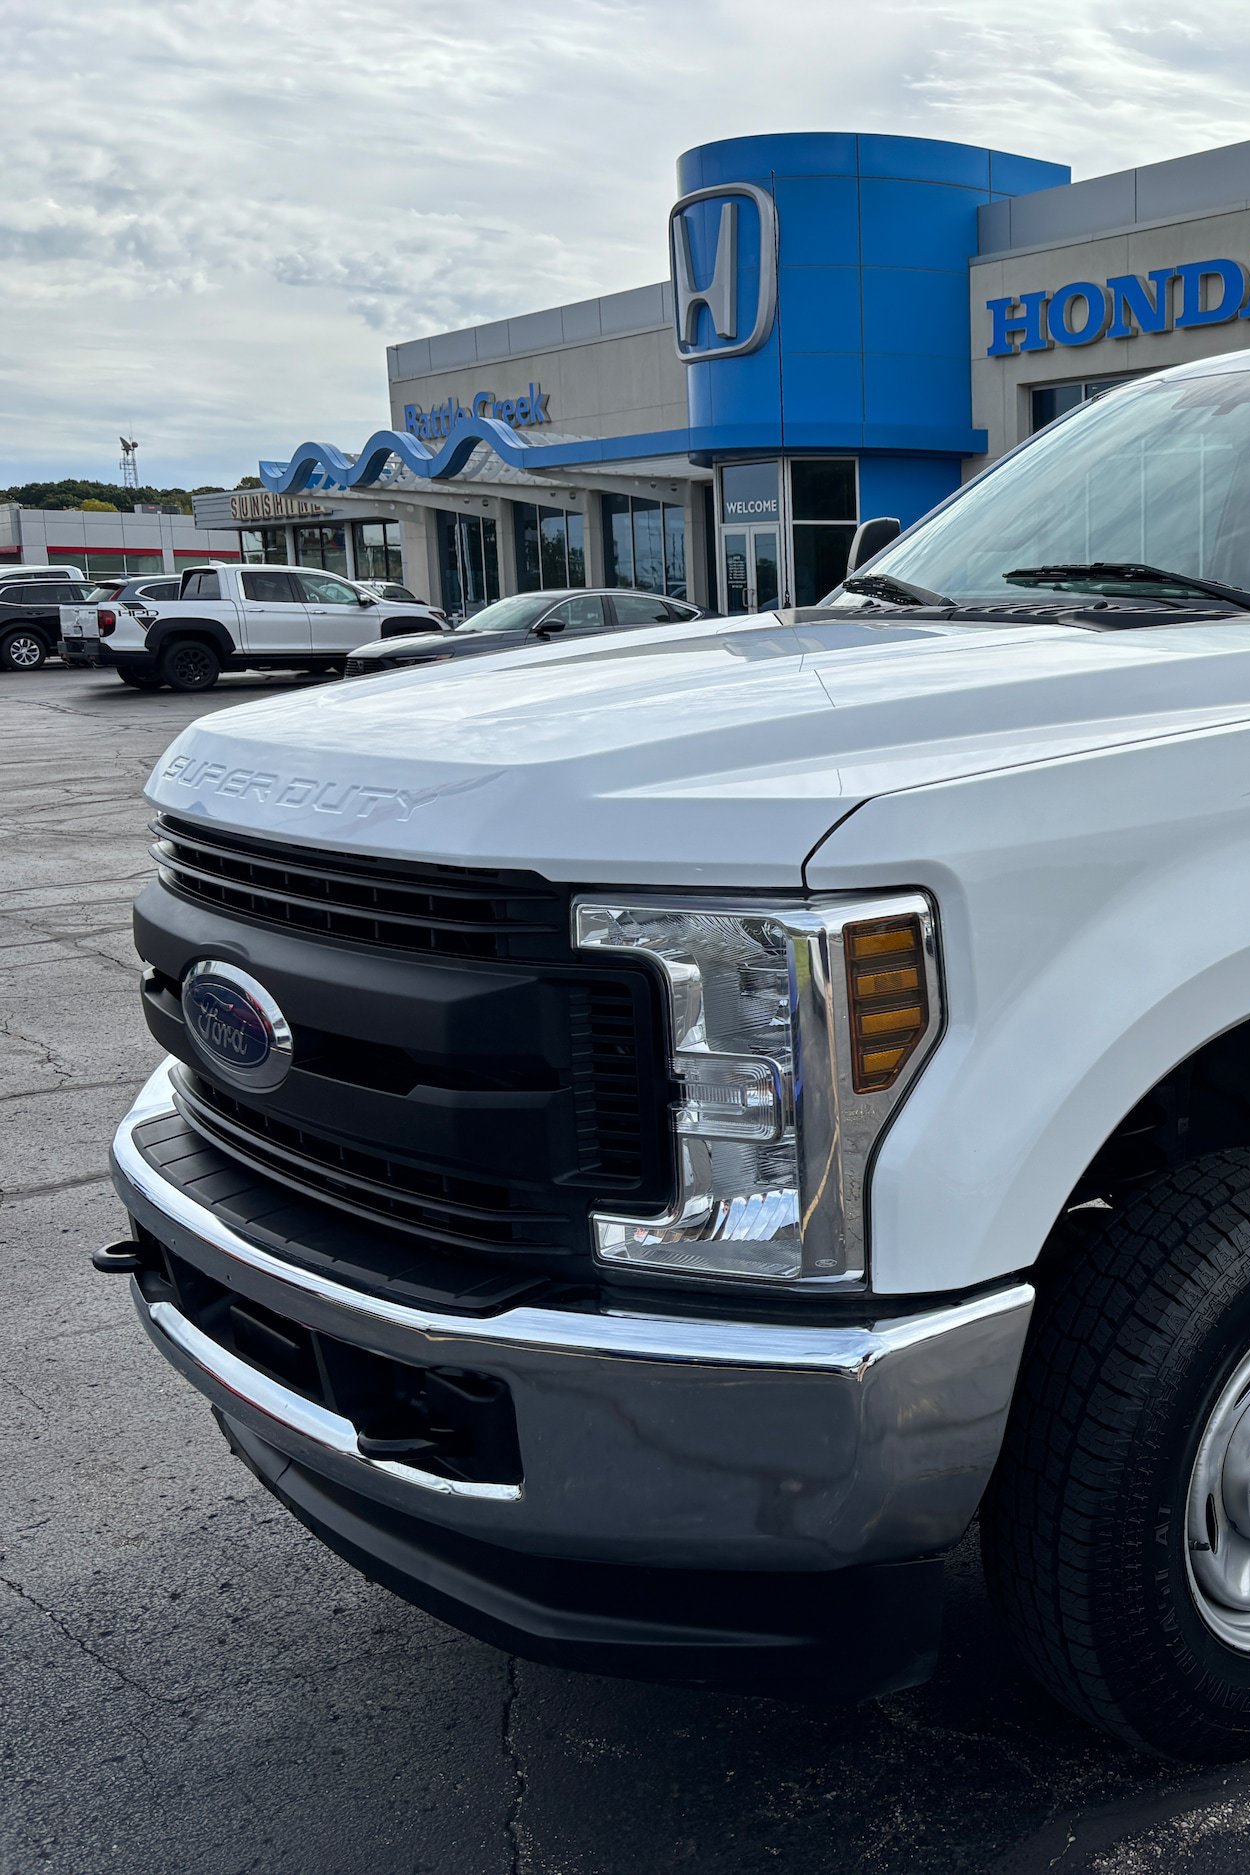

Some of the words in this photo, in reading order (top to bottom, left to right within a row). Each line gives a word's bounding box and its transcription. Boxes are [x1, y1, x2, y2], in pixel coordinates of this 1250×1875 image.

[473, 383, 549, 428] Creek
[727, 499, 777, 514] WELCOME
[118, 609, 160, 617] HPD
[162, 756, 278, 803] SUPER
[275, 777, 439, 822] DUTY
[193, 991, 249, 1056] Ford
